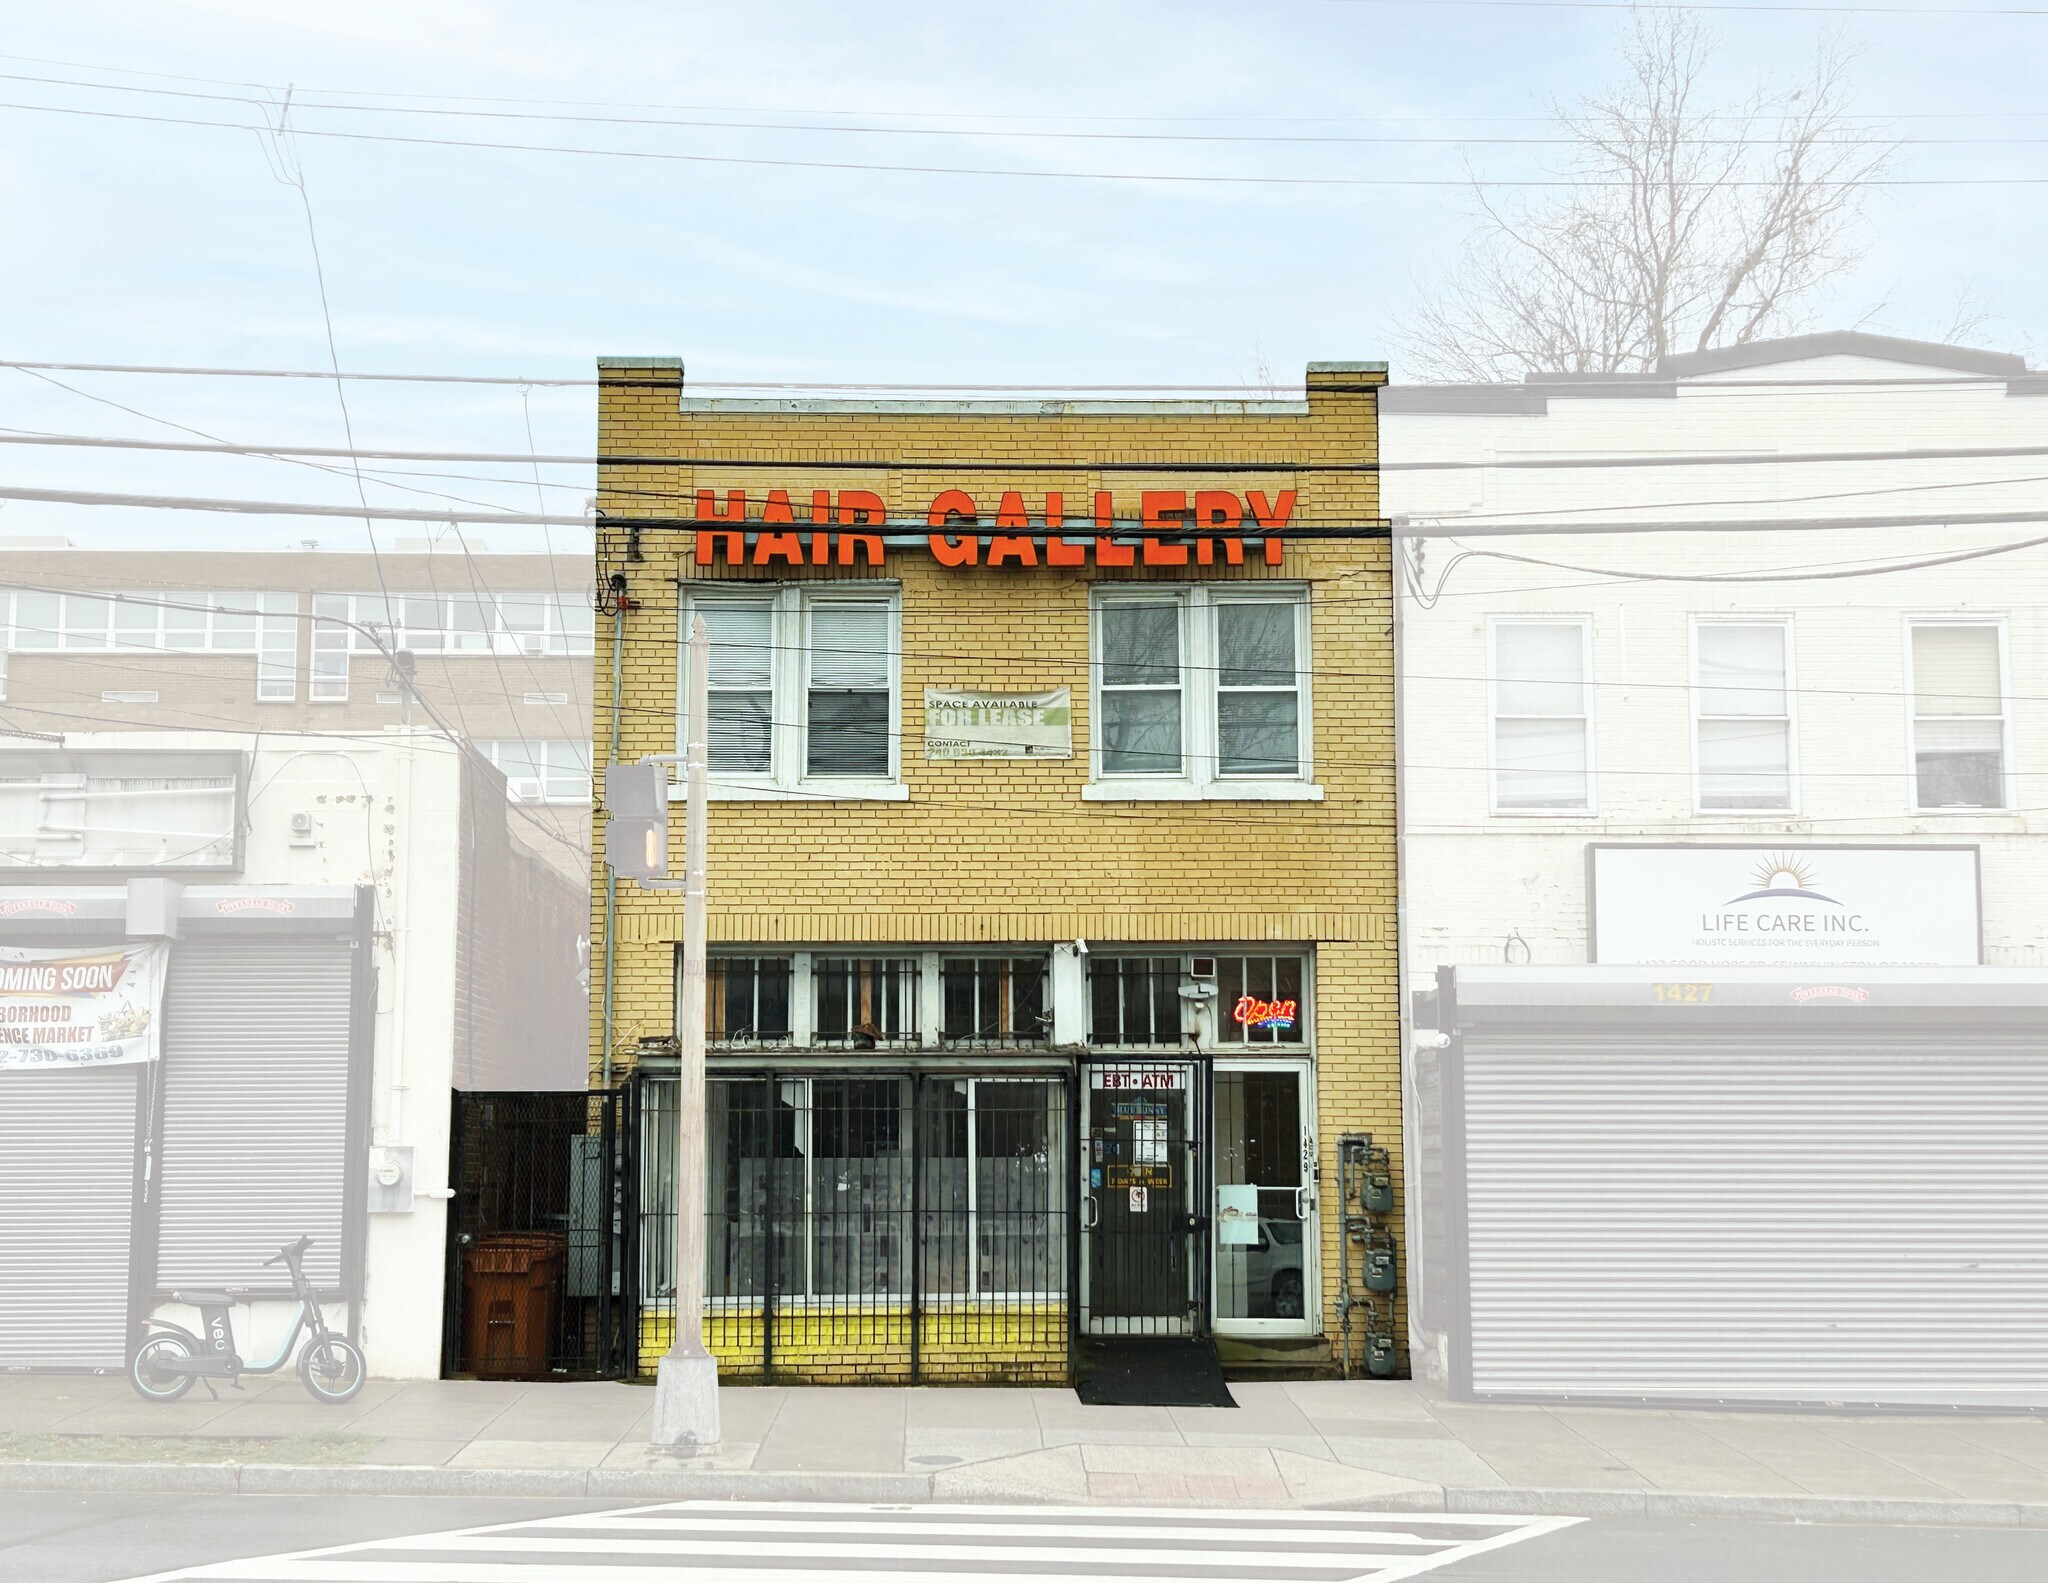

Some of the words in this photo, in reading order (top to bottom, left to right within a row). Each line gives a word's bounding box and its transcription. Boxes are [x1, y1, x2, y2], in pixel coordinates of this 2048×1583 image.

[696, 489, 886, 566] HAIR
[928, 489, 1298, 567] GALLERY
[929, 700, 969, 709] SPACE
[972, 700, 1038, 709] AVAILABLE
[928, 709, 972, 726] FOR
[979, 709, 1045, 726] LEASE
[927, 740, 972, 748] CONTACT
[1702, 914, 1749, 931] LIFE
[1757, 914, 1816, 932] CARE
[1824, 915, 1869, 932] INC.
[1768, 939, 1785, 947] FOR
[1787, 939, 1803, 947] THE
[1805, 939, 1845, 947] EVERYDAY
[1846, 939, 1880, 947] PERSON
[61, 965, 113, 989] SOON
[1653, 983, 1712, 1001] 1427
[32, 1026, 95, 1044] MARKET
[1103, 1074, 1130, 1088] EBT
[1142, 1074, 1174, 1088] ATM
